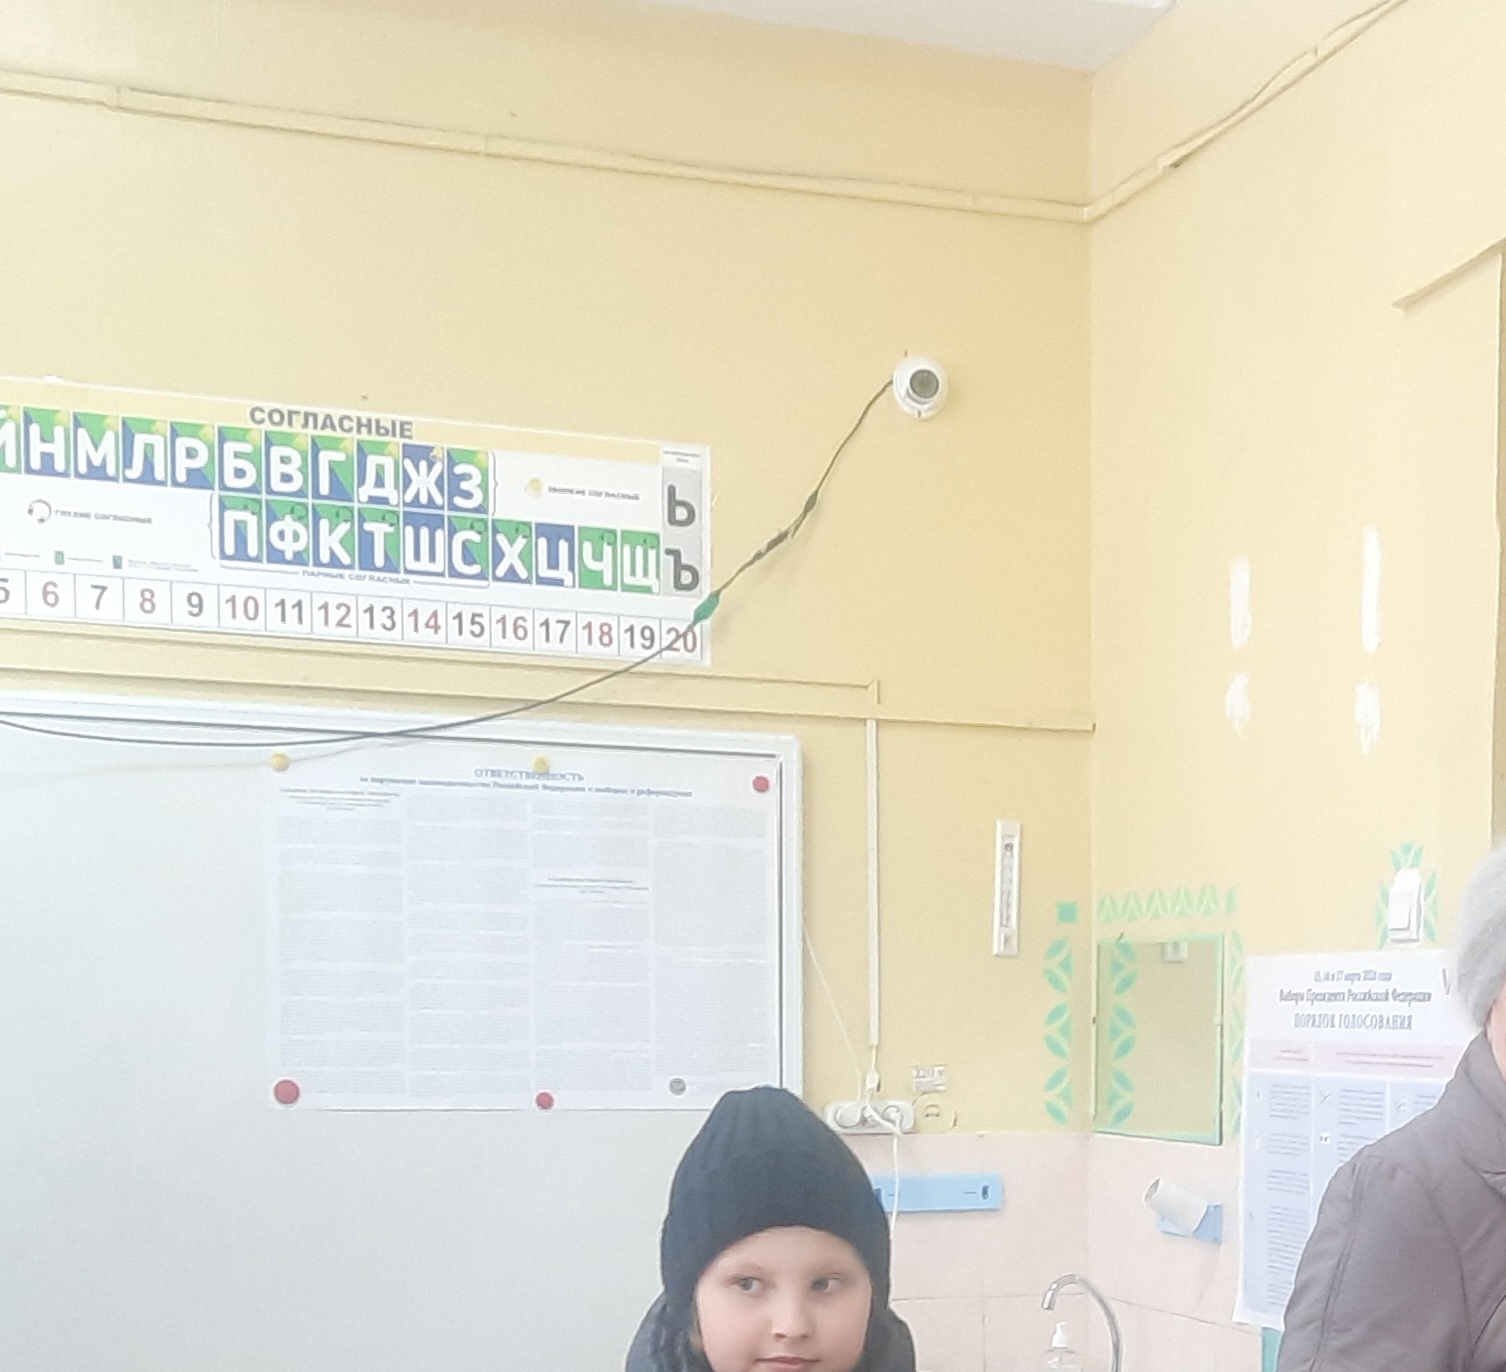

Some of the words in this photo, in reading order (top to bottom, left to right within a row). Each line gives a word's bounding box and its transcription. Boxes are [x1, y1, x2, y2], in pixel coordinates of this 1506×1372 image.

[250, 406, 414, 439] СОГЛАСНЫЕ
[29, 423, 66, 473] Н
[77, 427, 116, 477] М
[124, 433, 165, 481] Л
[175, 437, 209, 483] Р
[223, 441, 257, 490] Б
[270, 446, 303, 493] В
[319, 450, 346, 495] Г
[359, 455, 398, 505] Д
[403, 458, 443, 506] Ж
[453, 463, 483, 508] З
[667, 485, 696, 527] Ь
[224, 509, 258, 558] П
[269, 515, 308, 561] Ф
[319, 518, 351, 566] К
[363, 522, 395, 568] Т
[404, 525, 445, 573] Ш
[452, 531, 482, 575] С
[495, 534, 528, 580] Х
[537, 536, 573, 587] Ц
[582, 540, 613, 587] Ч
[623, 544, 660, 593] Щ
[665, 548, 700, 591] Ъ
[42, 581, 60, 608] 6
[91, 584, 108, 610] 7
[139, 588, 156, 614] 8
[186, 591, 204, 618] 9
[225, 594, 259, 622] 10
[275, 598, 303, 625] 11
[318, 601, 352, 629] 12
[363, 603, 396, 631] 13
[408, 608, 441, 635] 14
[453, 611, 485, 638] 15
[496, 614, 528, 641] 16
[539, 617, 571, 644] 17
[582, 621, 614, 647] 18
[624, 624, 655, 650] 19
[666, 627, 698, 653] 20
